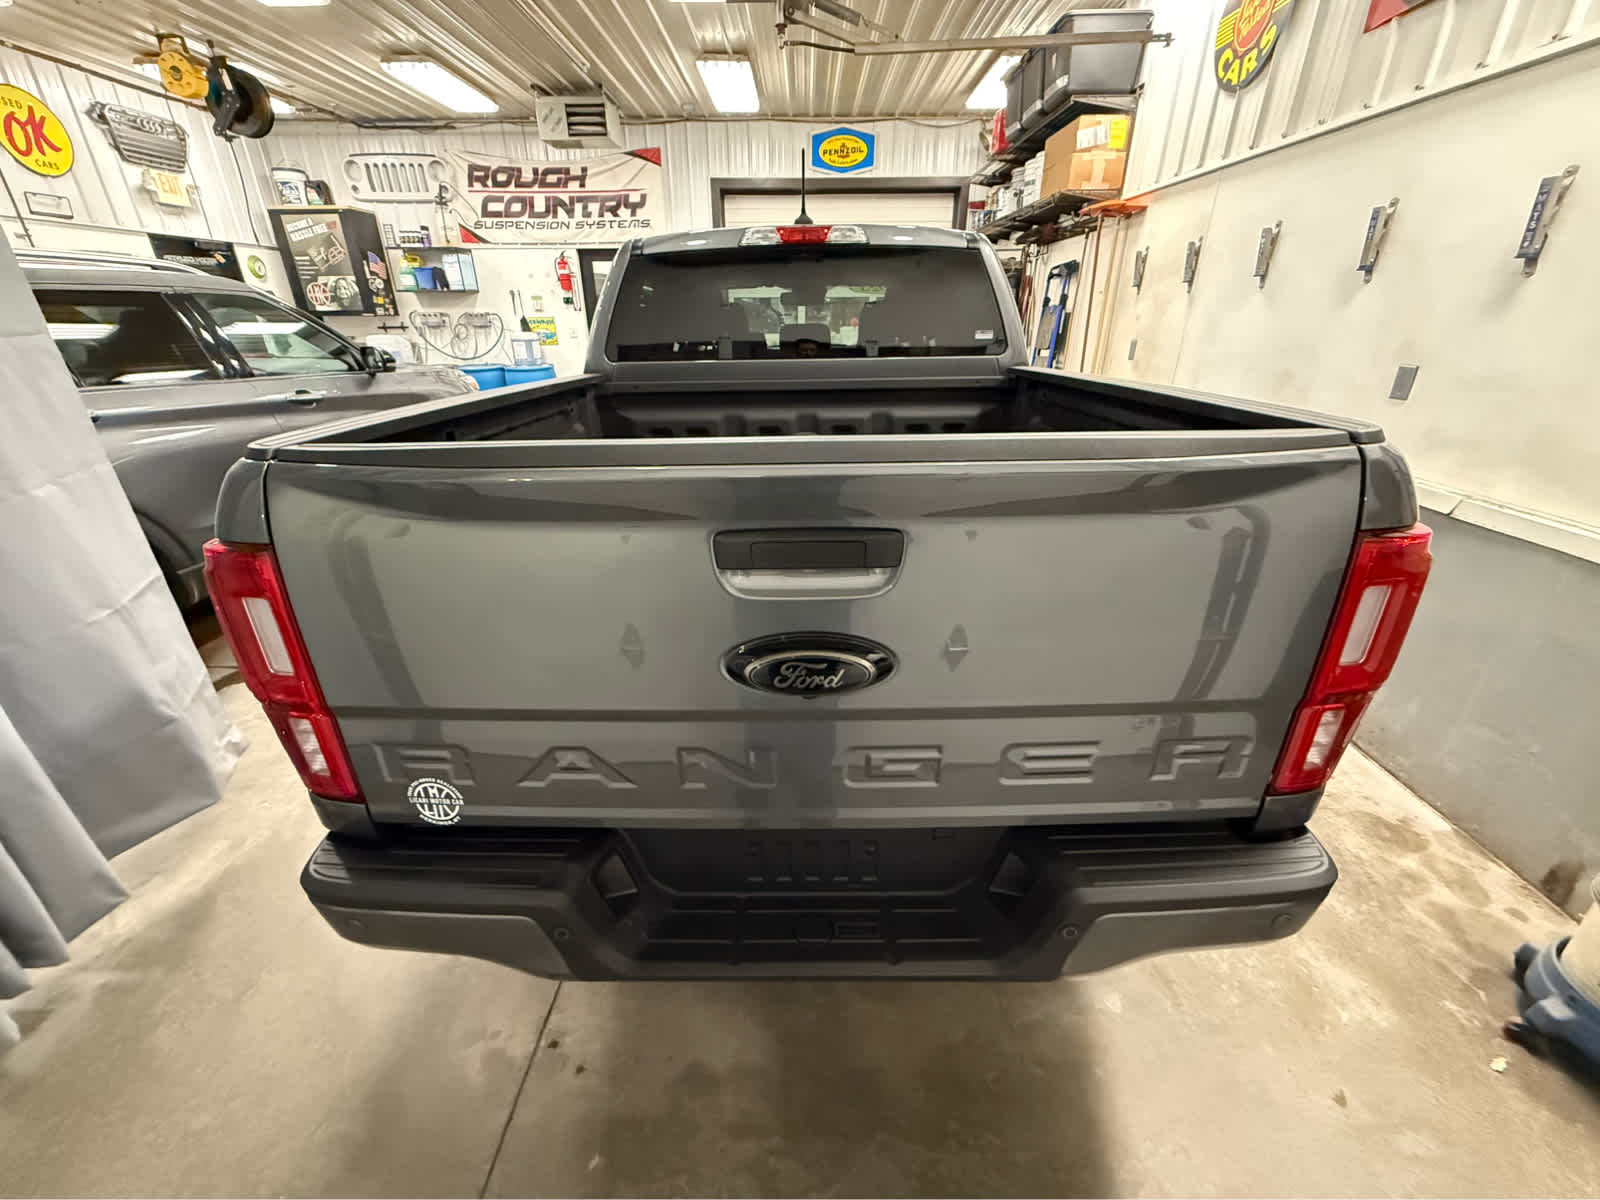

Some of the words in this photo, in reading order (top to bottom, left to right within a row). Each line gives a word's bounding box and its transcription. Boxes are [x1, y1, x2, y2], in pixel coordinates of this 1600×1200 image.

[1217, 22, 1278, 86] CARS
[0, 96, 23, 109] SED
[3, 104, 63, 157] OK
[34, 158, 60, 170] CARS
[822, 145, 865, 157] PENNZOIL
[467, 163, 588, 189] ROUGH
[481, 192, 648, 219] COUNTRY
[473, 219, 571, 230] SUSPENSION
[575, 218, 652, 230] SYSTEMS
[773, 661, 846, 689] Ford
[371, 735, 1256, 790] RANGER
